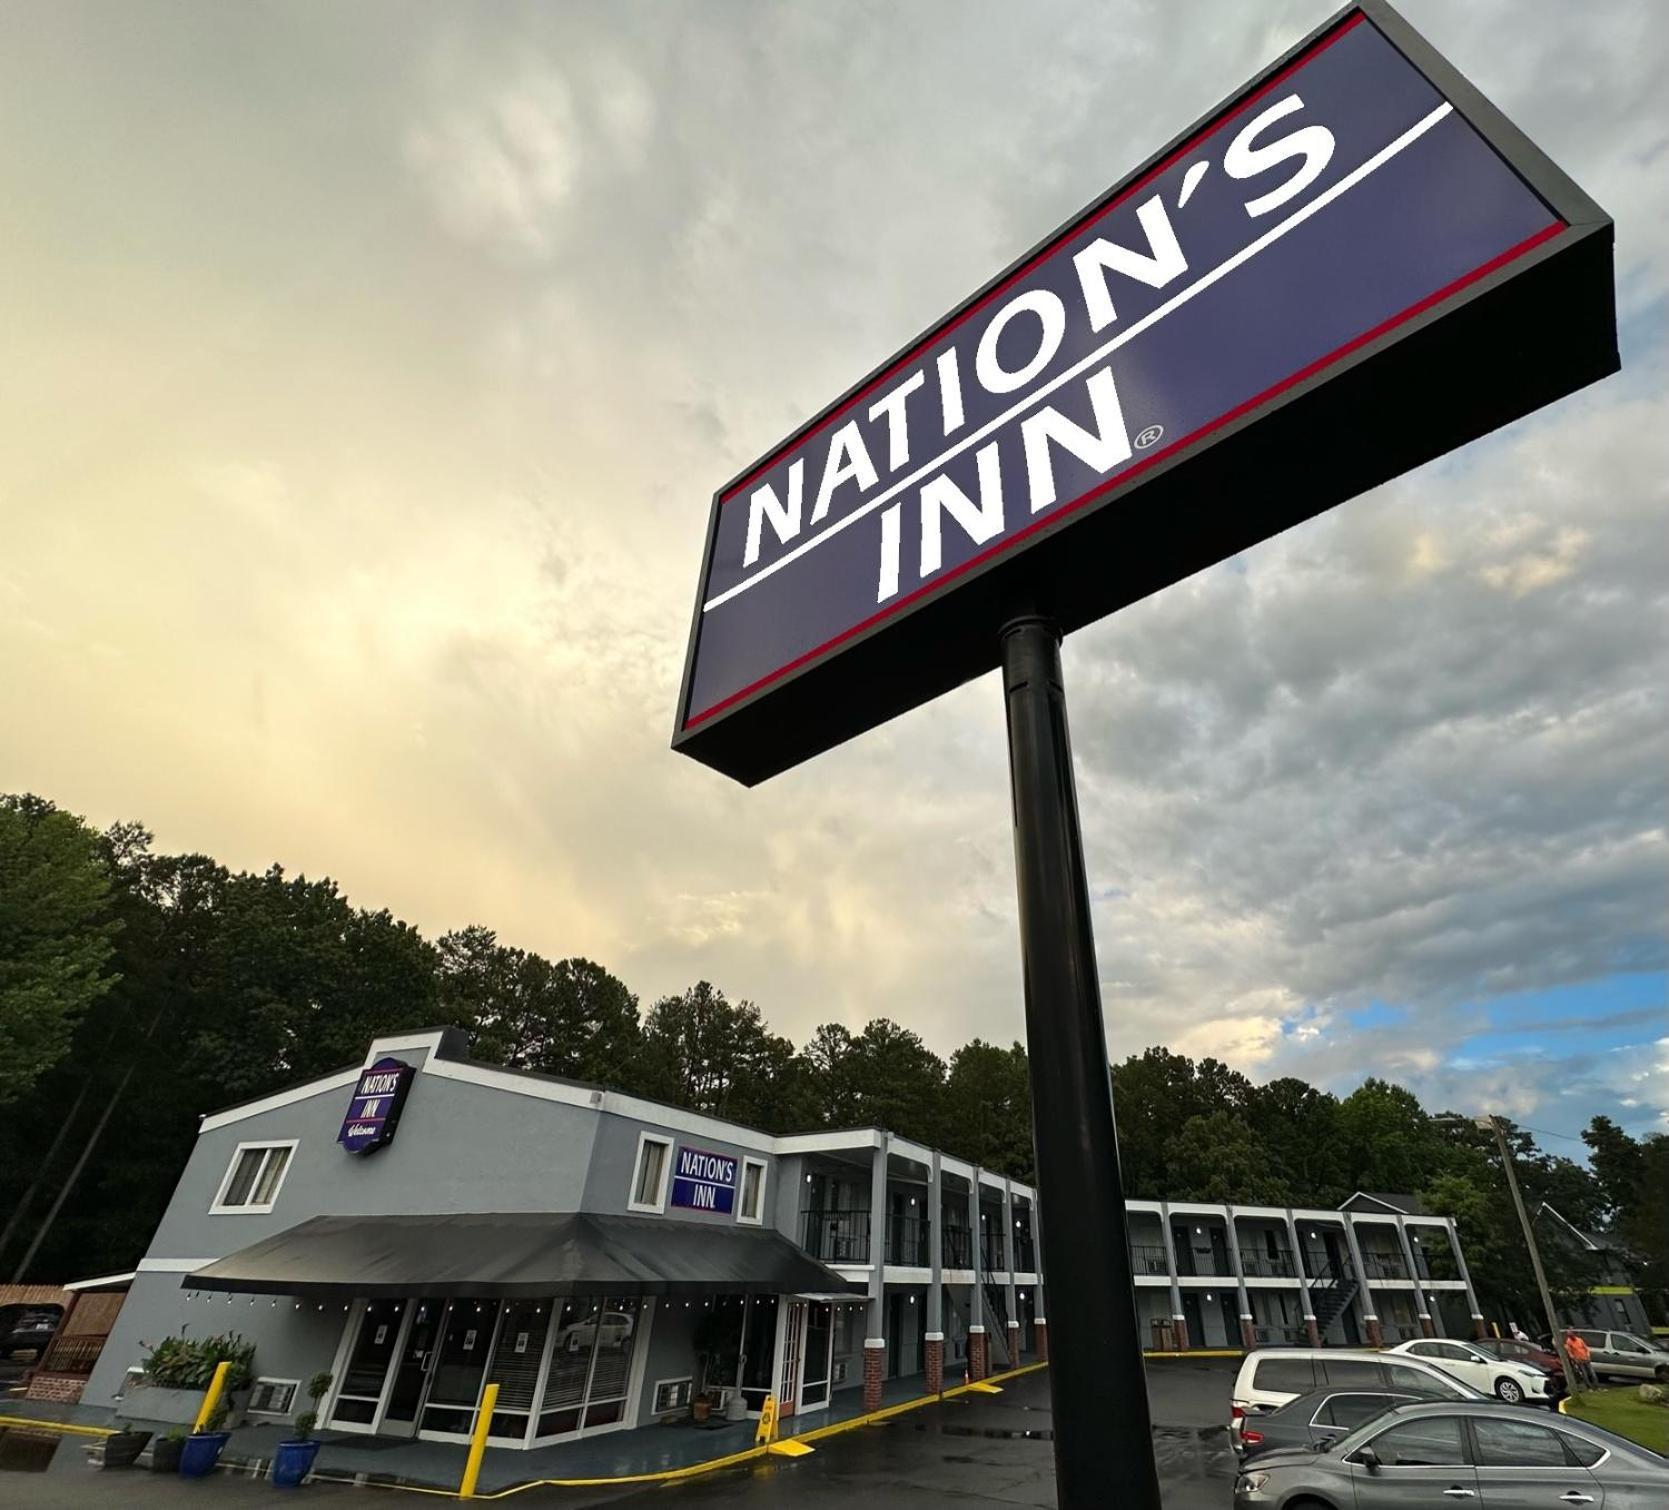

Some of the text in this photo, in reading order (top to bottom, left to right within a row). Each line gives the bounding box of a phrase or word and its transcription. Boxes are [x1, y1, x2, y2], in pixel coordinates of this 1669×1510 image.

[743, 94, 1335, 567] NATION'S
[877, 367, 1132, 604] INN
[361, 1073, 400, 1094] NATION'S
[360, 1099, 381, 1118] INN
[681, 1151, 733, 1182] NATION'S
[693, 1184, 716, 1209] INN
